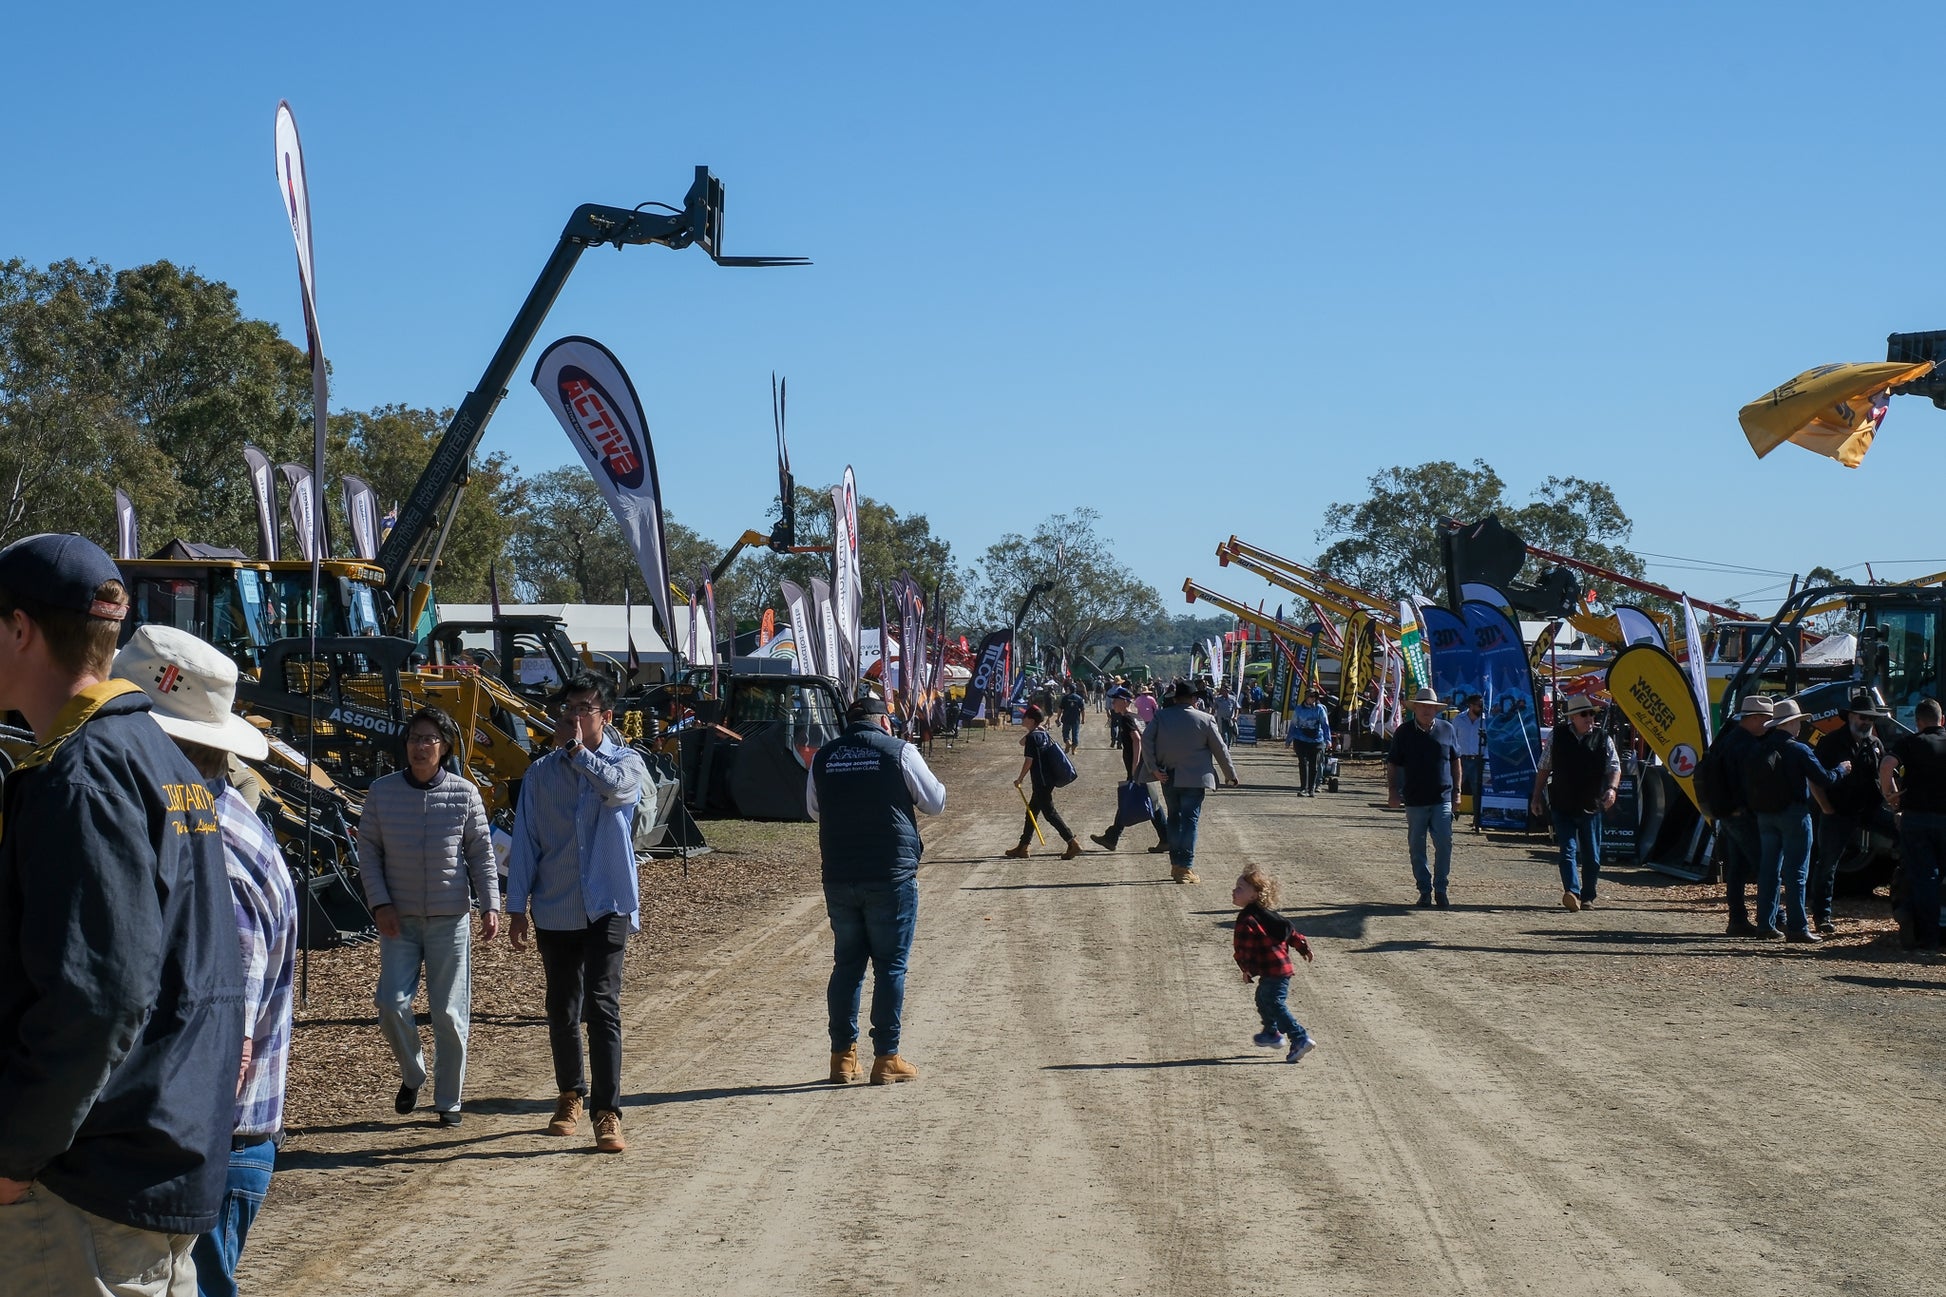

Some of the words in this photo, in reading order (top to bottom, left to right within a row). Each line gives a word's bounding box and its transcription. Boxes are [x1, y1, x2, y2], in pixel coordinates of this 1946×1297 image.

[560, 378, 640, 477] ACTIVE
[382, 506, 423, 571] ACTIVE
[415, 411, 475, 510] MACHINERY
[974, 642, 1005, 690] TILCO
[1629, 684, 1671, 733] NEUSON
[1637, 675, 1676, 725] WACKER
[1807, 707, 1839, 723] ELON
